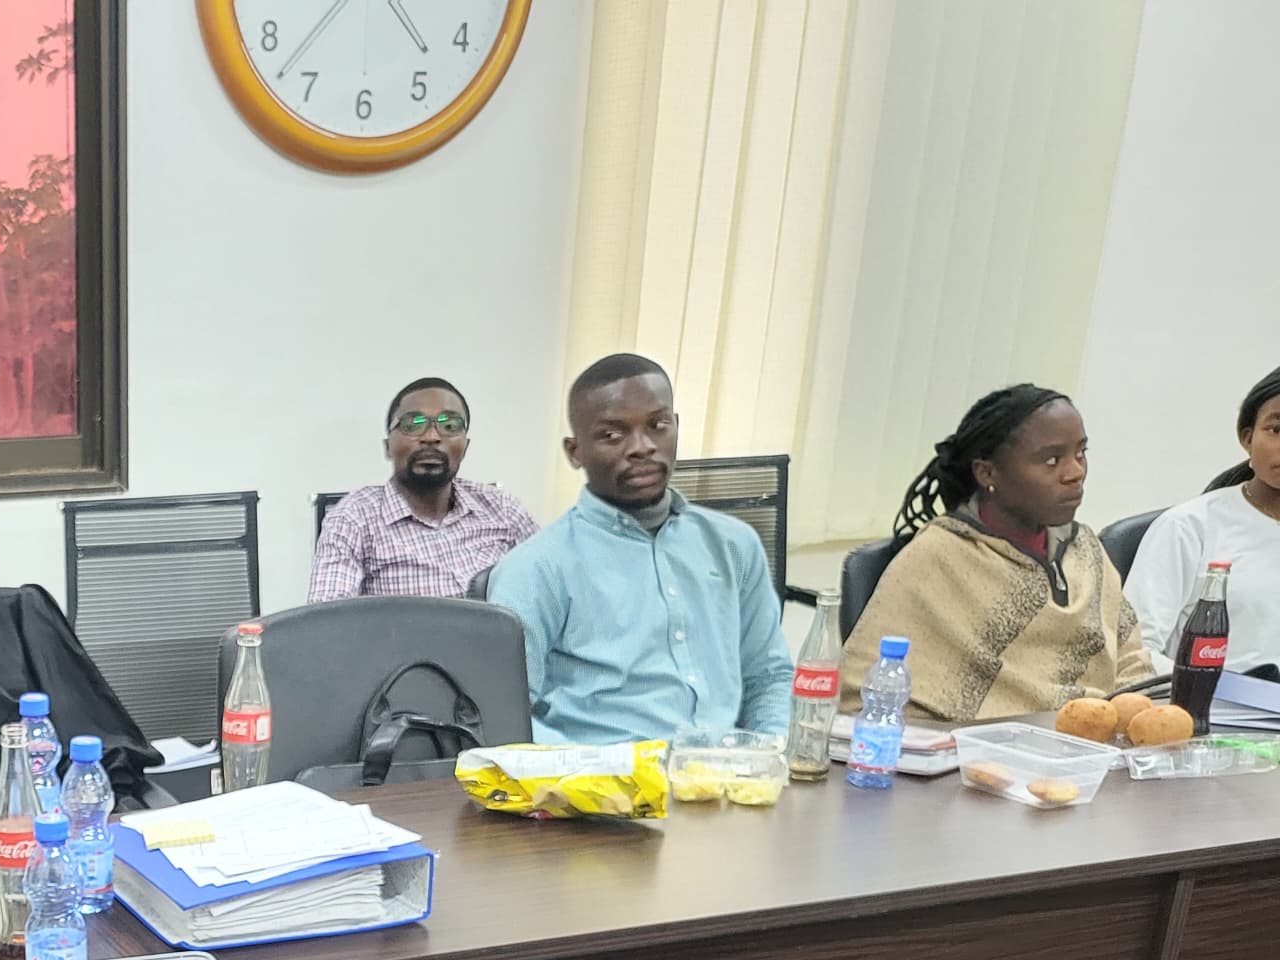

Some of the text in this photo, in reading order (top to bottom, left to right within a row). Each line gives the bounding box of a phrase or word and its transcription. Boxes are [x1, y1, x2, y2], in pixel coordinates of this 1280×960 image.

[260, 20, 278, 51] 8
[452, 22, 470, 52] 4
[300, 71, 319, 102] 7
[410, 71, 428, 101] 5
[355, 89, 373, 120] 6
